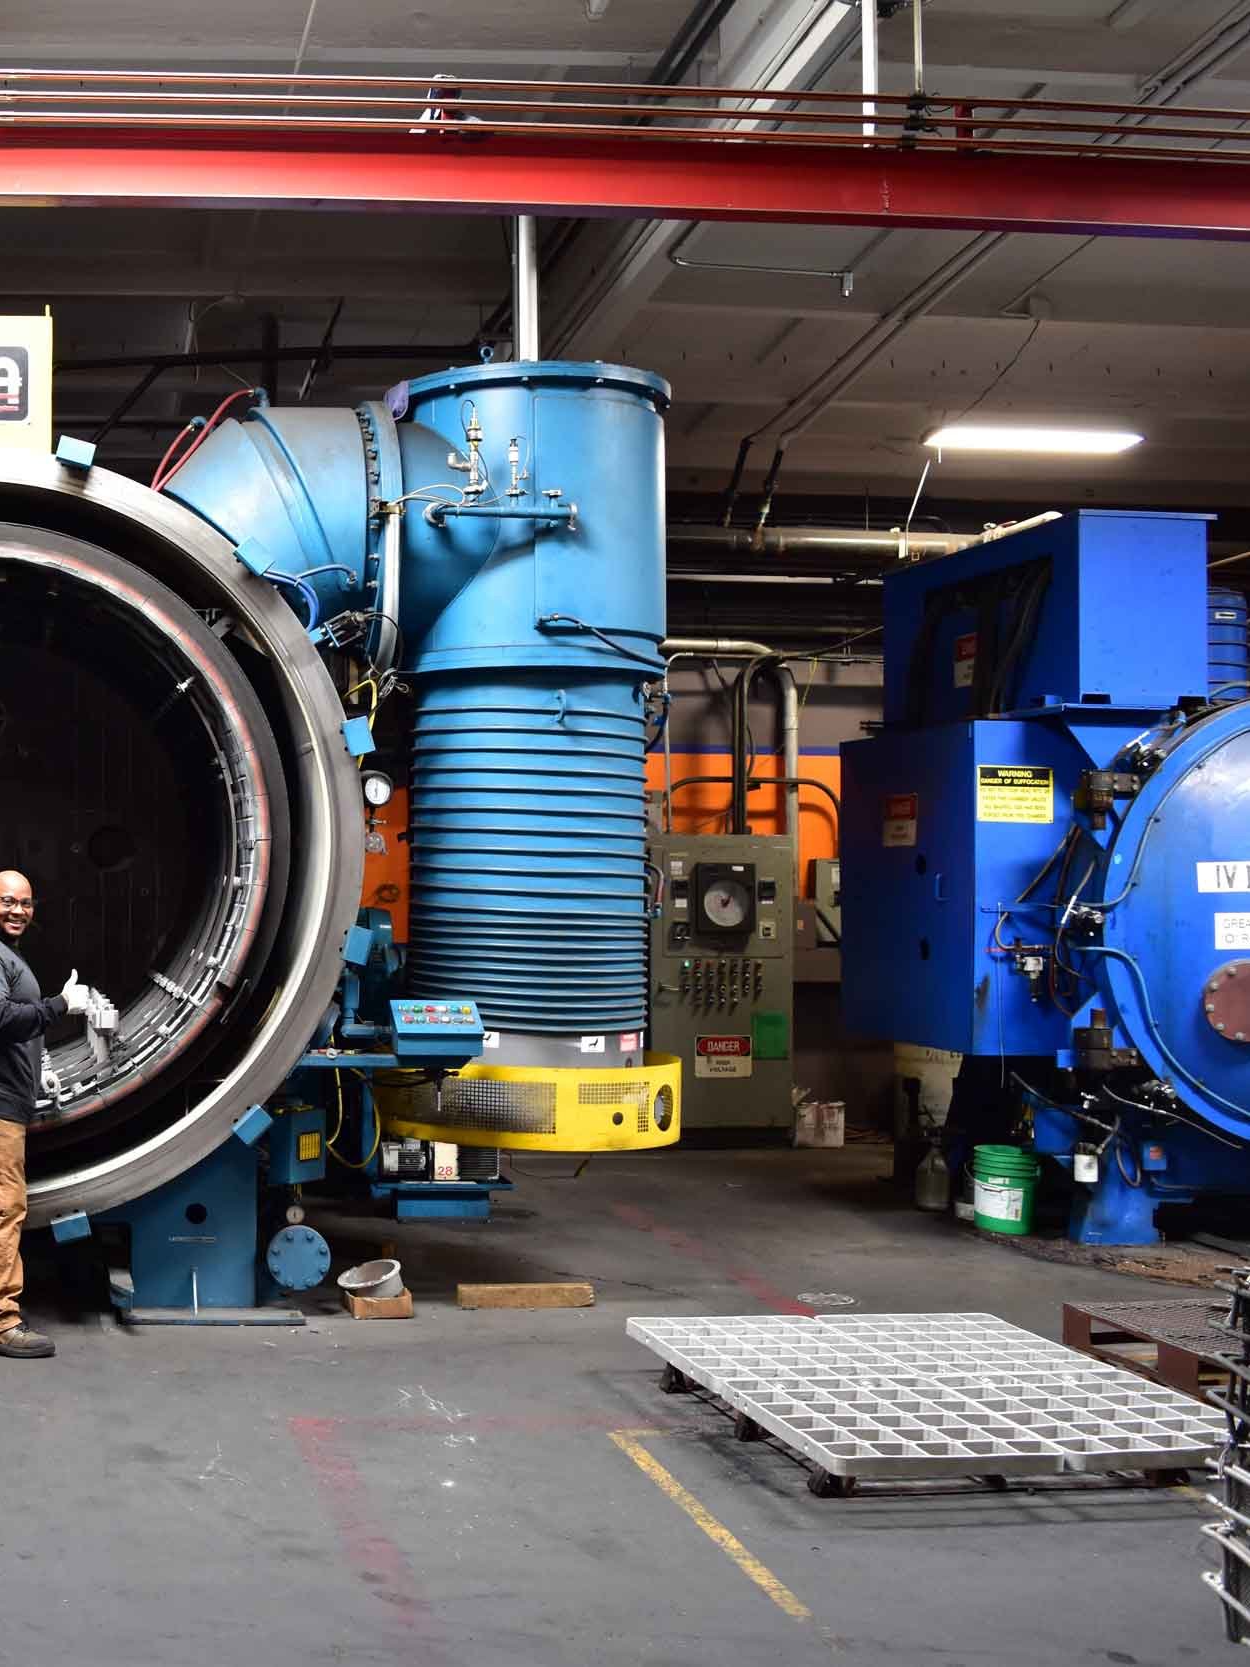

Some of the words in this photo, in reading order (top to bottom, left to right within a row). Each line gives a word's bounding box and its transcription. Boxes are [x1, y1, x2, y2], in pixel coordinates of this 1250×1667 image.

[997, 769, 1033, 778] WARNING
[707, 1040, 741, 1052] DANGER
[437, 1166, 453, 1176] 28
